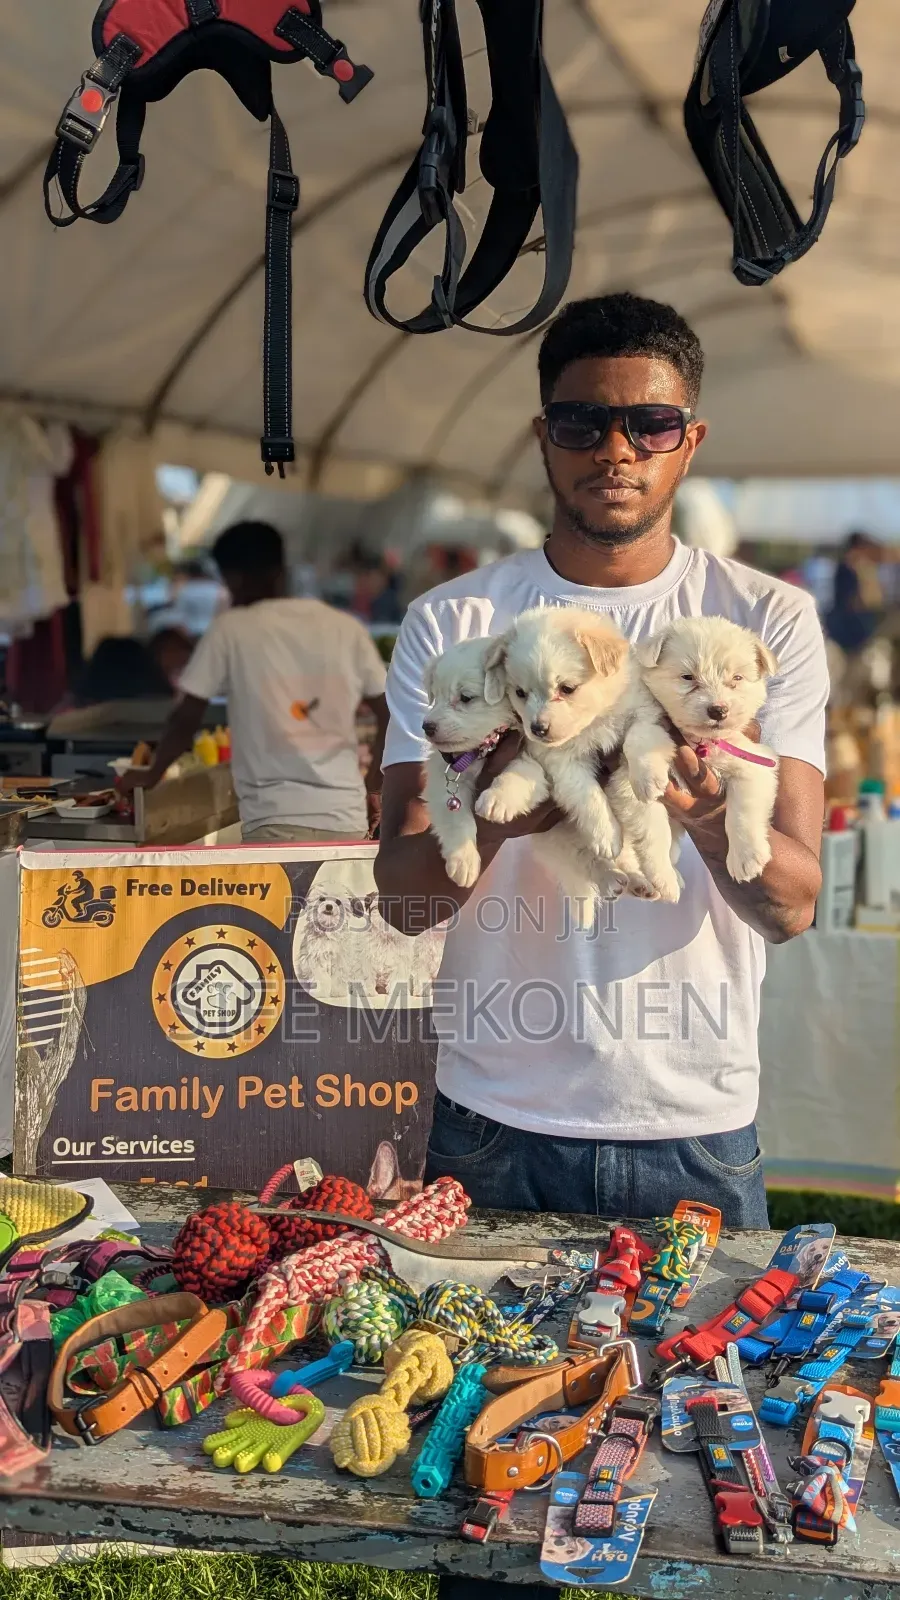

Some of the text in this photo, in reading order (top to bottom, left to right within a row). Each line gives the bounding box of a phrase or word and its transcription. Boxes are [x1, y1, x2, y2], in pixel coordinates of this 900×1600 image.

[126, 878, 272, 900] Free Delivery
[189, 966, 222, 998] FAMILY
[202, 1008, 236, 1017] PET SHOP
[90, 1073, 419, 1119] Family Pet Shop
[53, 1135, 195, 1156] Our Services
[591, 1553, 628, 1562] D&H
